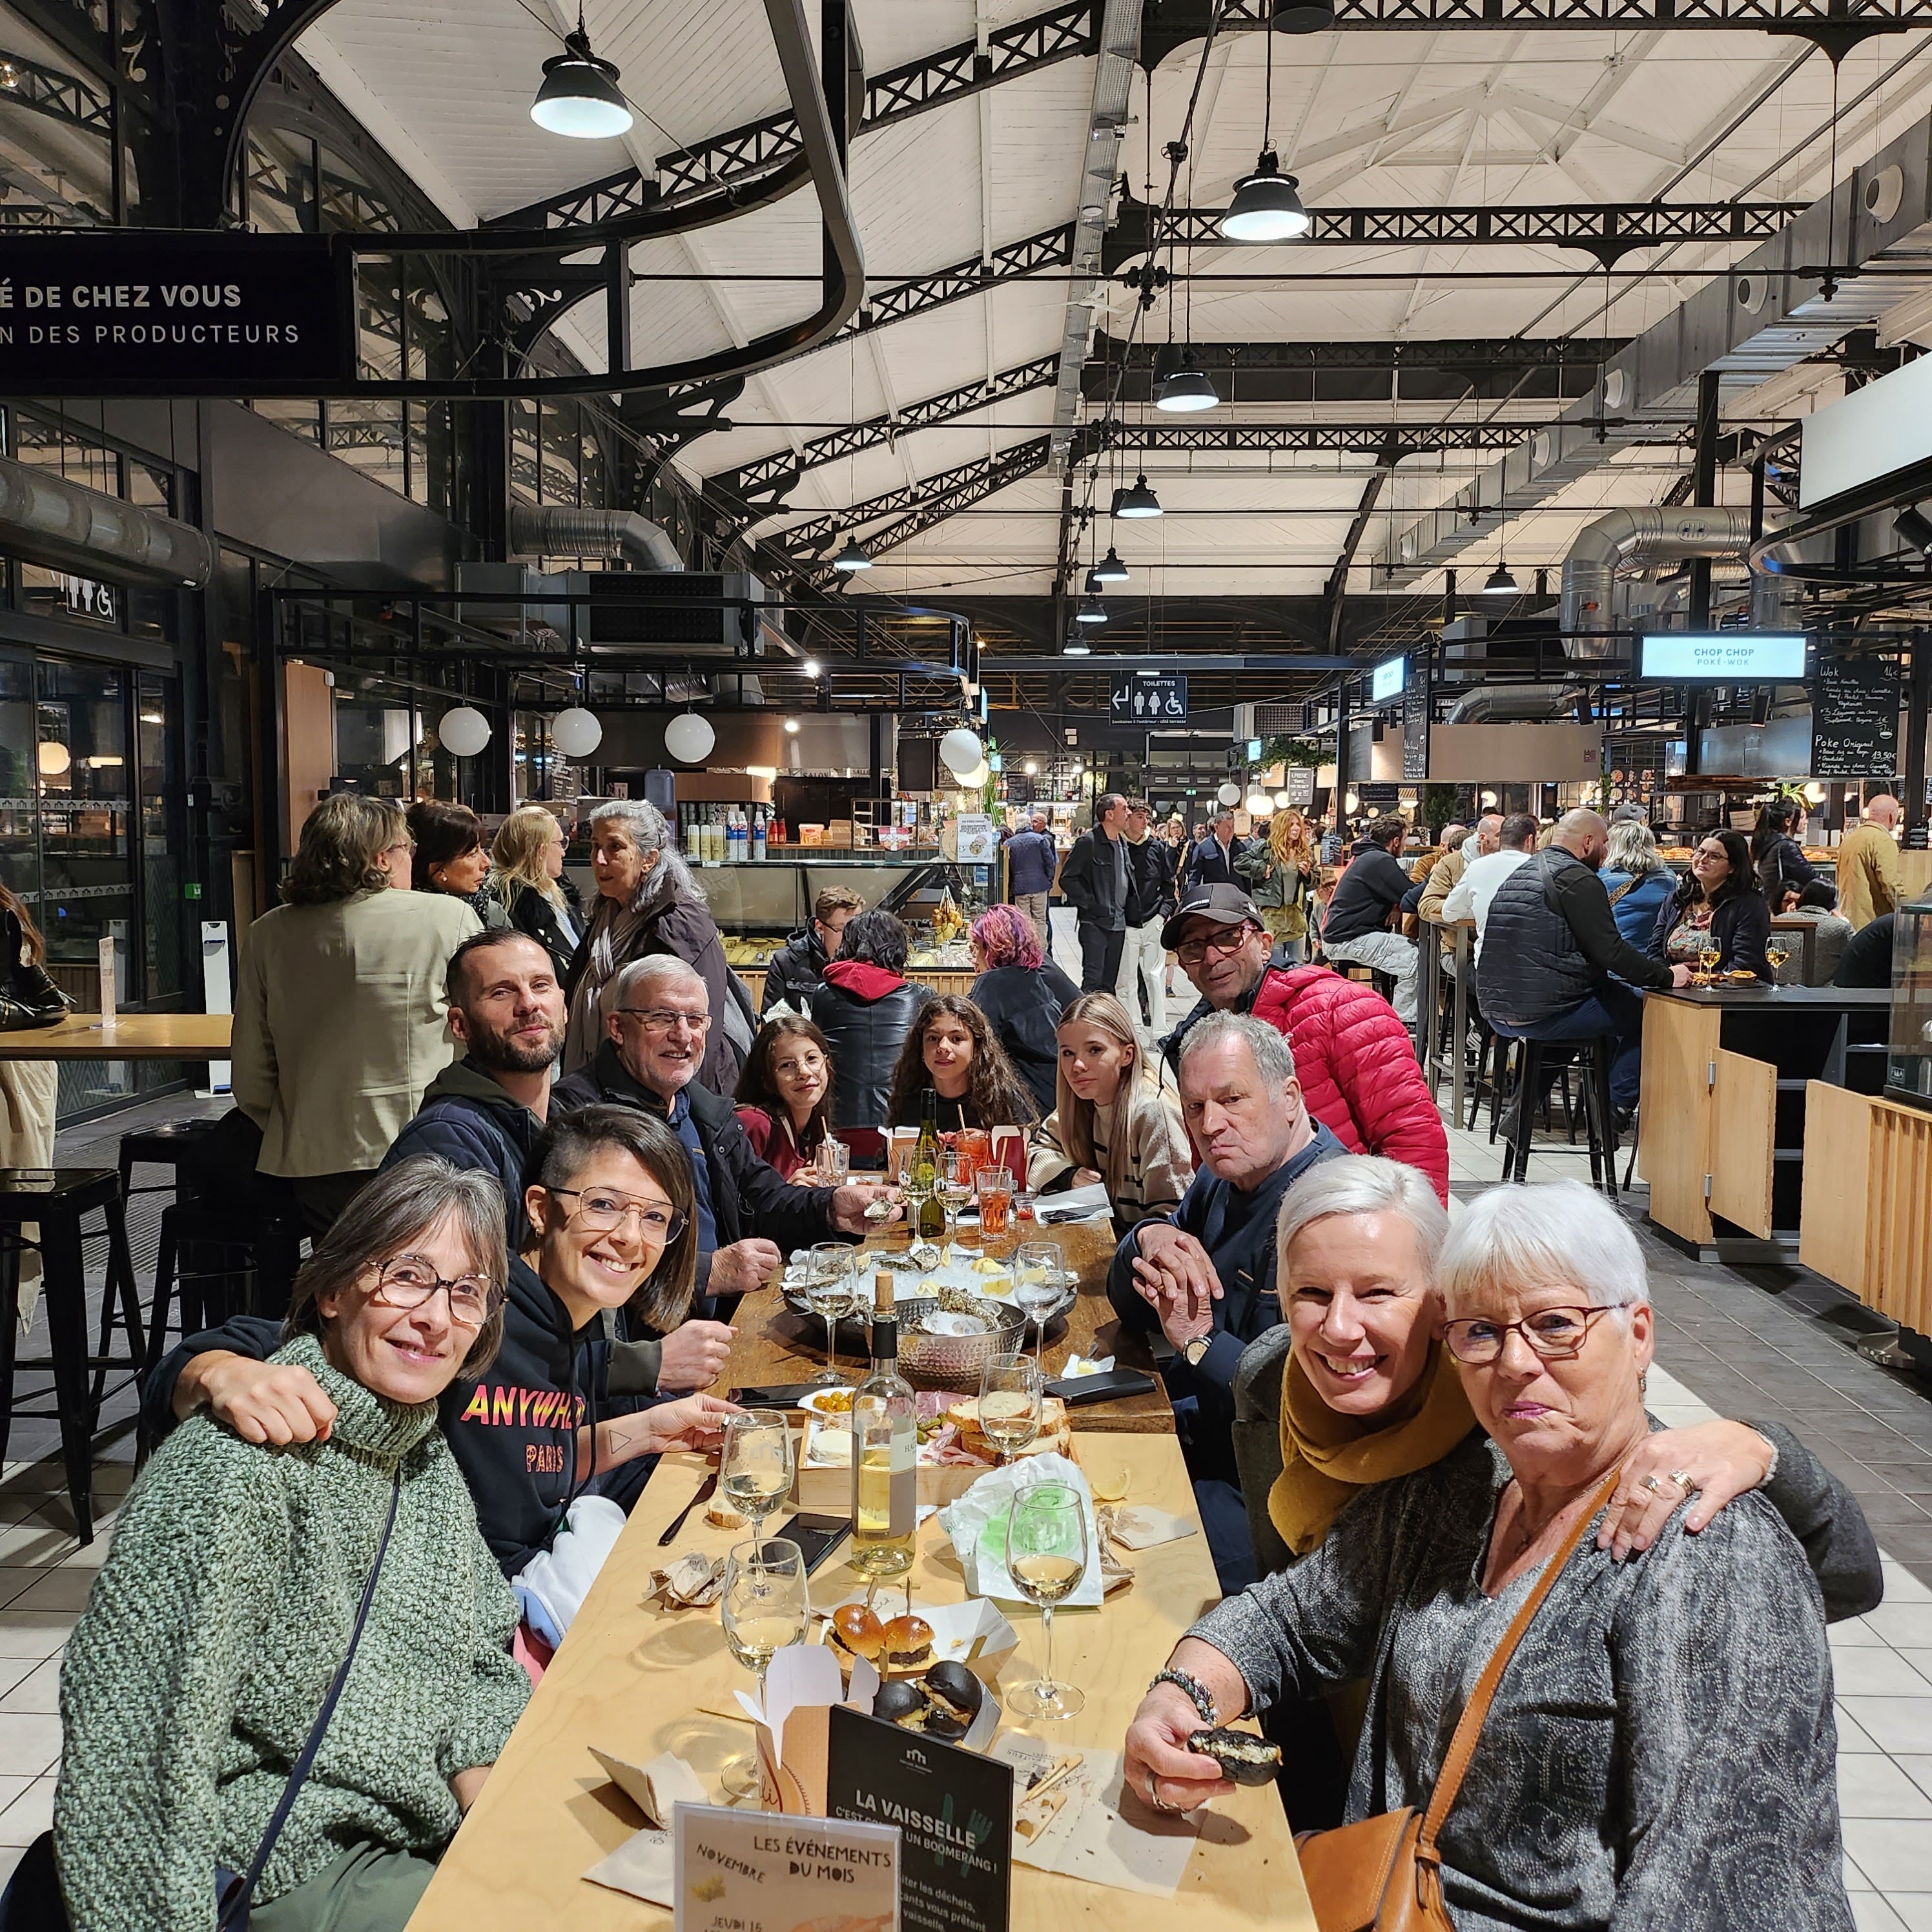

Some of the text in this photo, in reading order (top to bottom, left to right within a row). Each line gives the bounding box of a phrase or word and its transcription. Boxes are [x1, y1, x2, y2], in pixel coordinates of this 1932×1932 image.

[0, 278, 242, 308] É DE CHEZ VOUS
[0, 324, 298, 344] N DES PRODUCTEURS
[1697, 657, 1749, 665] POKÉ-WOK
[1820, 666, 1839, 677] Wok
[1815, 734, 1874, 752] Poke Original
[526, 1444, 564, 1473] PARIS
[856, 1789, 976, 1850] LA VAISSELLE
[754, 1836, 892, 1868] LES ÉVÉNEMENTS
[836, 1805, 863, 1822] C'EST
[905, 1831, 922, 1846] UN
[923, 1837, 992, 1873] BOOMERANG
[696, 1843, 766, 1884] NOVEMBRE
[788, 1861, 855, 1884] DU MOIS
[901, 1874, 918, 1889] iter
[920, 1880, 933, 1896] les
[711, 1914, 745, 1931] JEUDI
[926, 1901, 949, 1918] vous
[951, 1911, 987, 1932] prêtent
